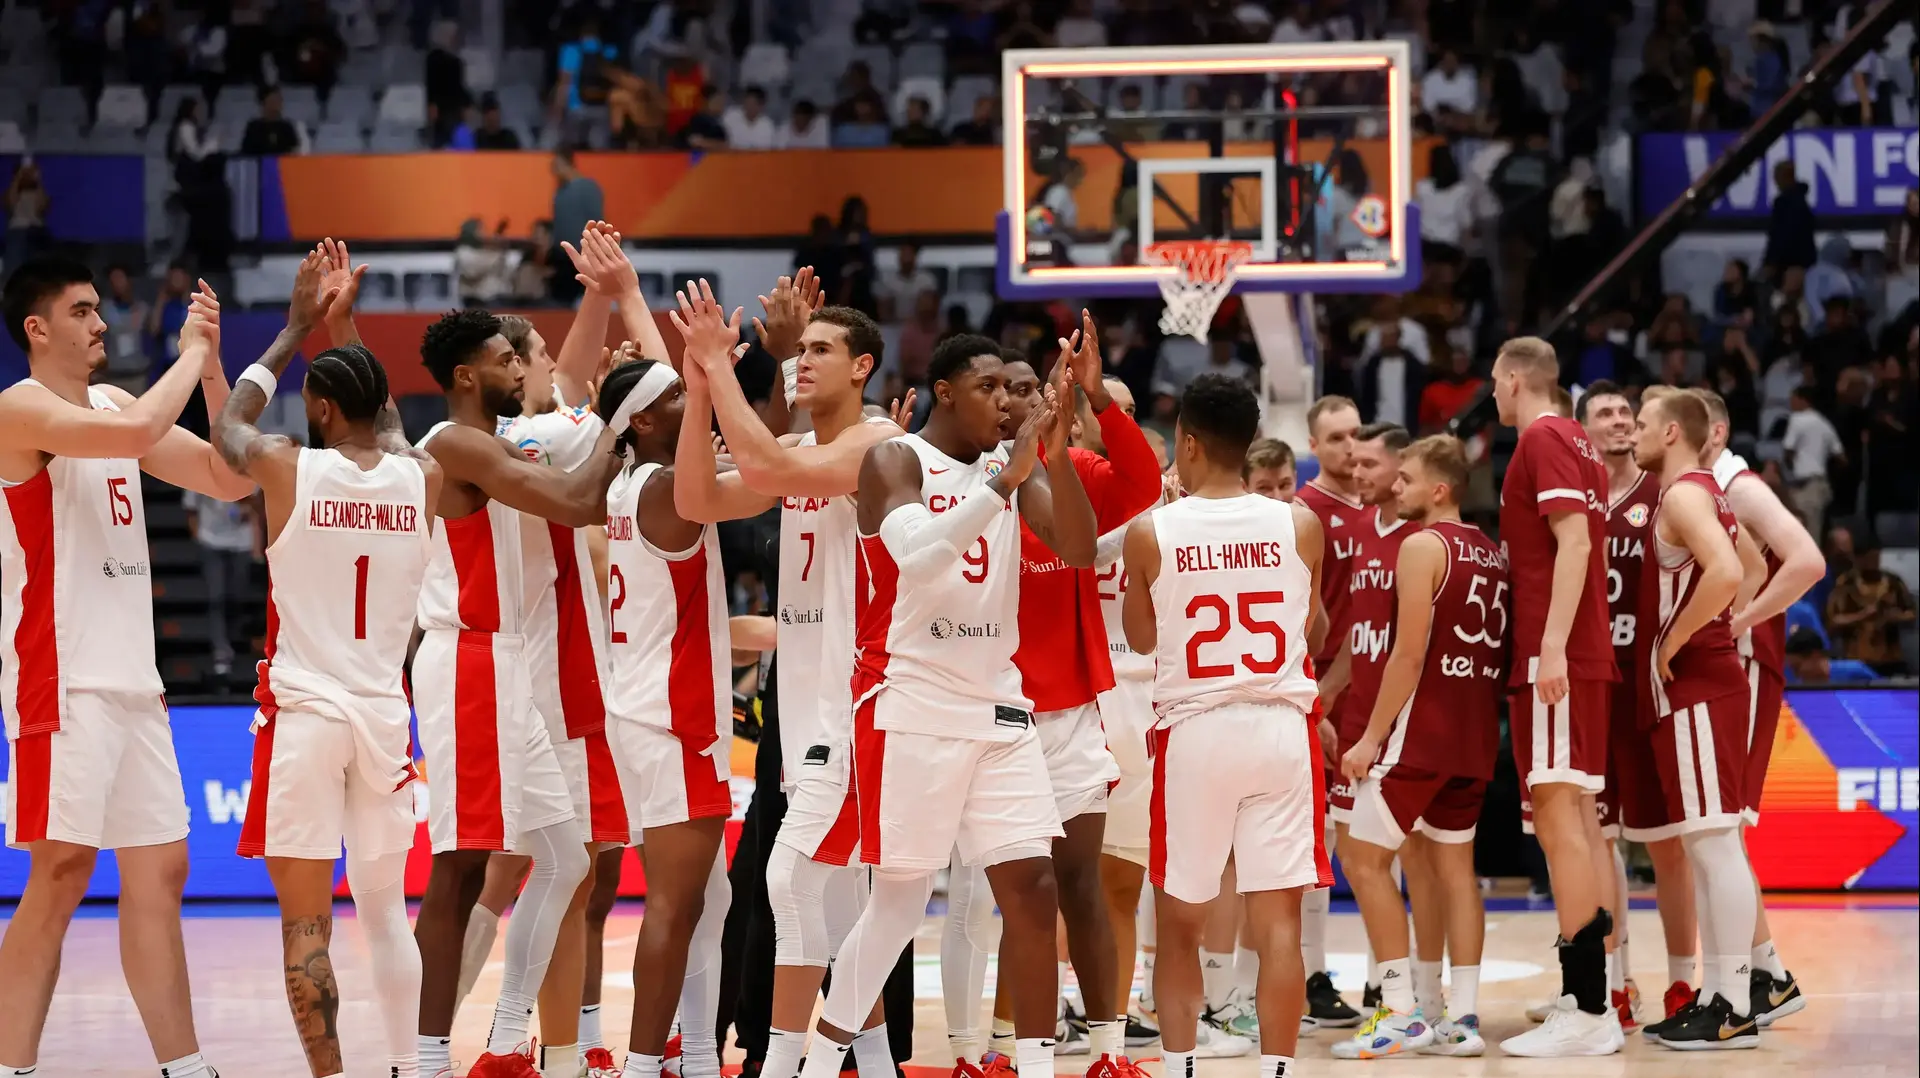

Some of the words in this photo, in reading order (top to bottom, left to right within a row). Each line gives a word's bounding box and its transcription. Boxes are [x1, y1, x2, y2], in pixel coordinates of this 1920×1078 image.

[107, 478, 133, 526] 15
[309, 500, 417, 532] ALEXANDER-WALKER
[119, 562, 136, 576] Sun
[801, 532, 815, 581] 7
[962, 535, 989, 583] 9
[1029, 561, 1055, 573] Sun
[1176, 542, 1281, 573] BELL-HAYNES
[354, 555, 370, 640] 1
[610, 564, 627, 643] 2
[1453, 574, 1509, 648] 55
[957, 624, 983, 637] Sun
[1185, 591, 1286, 679] 25
